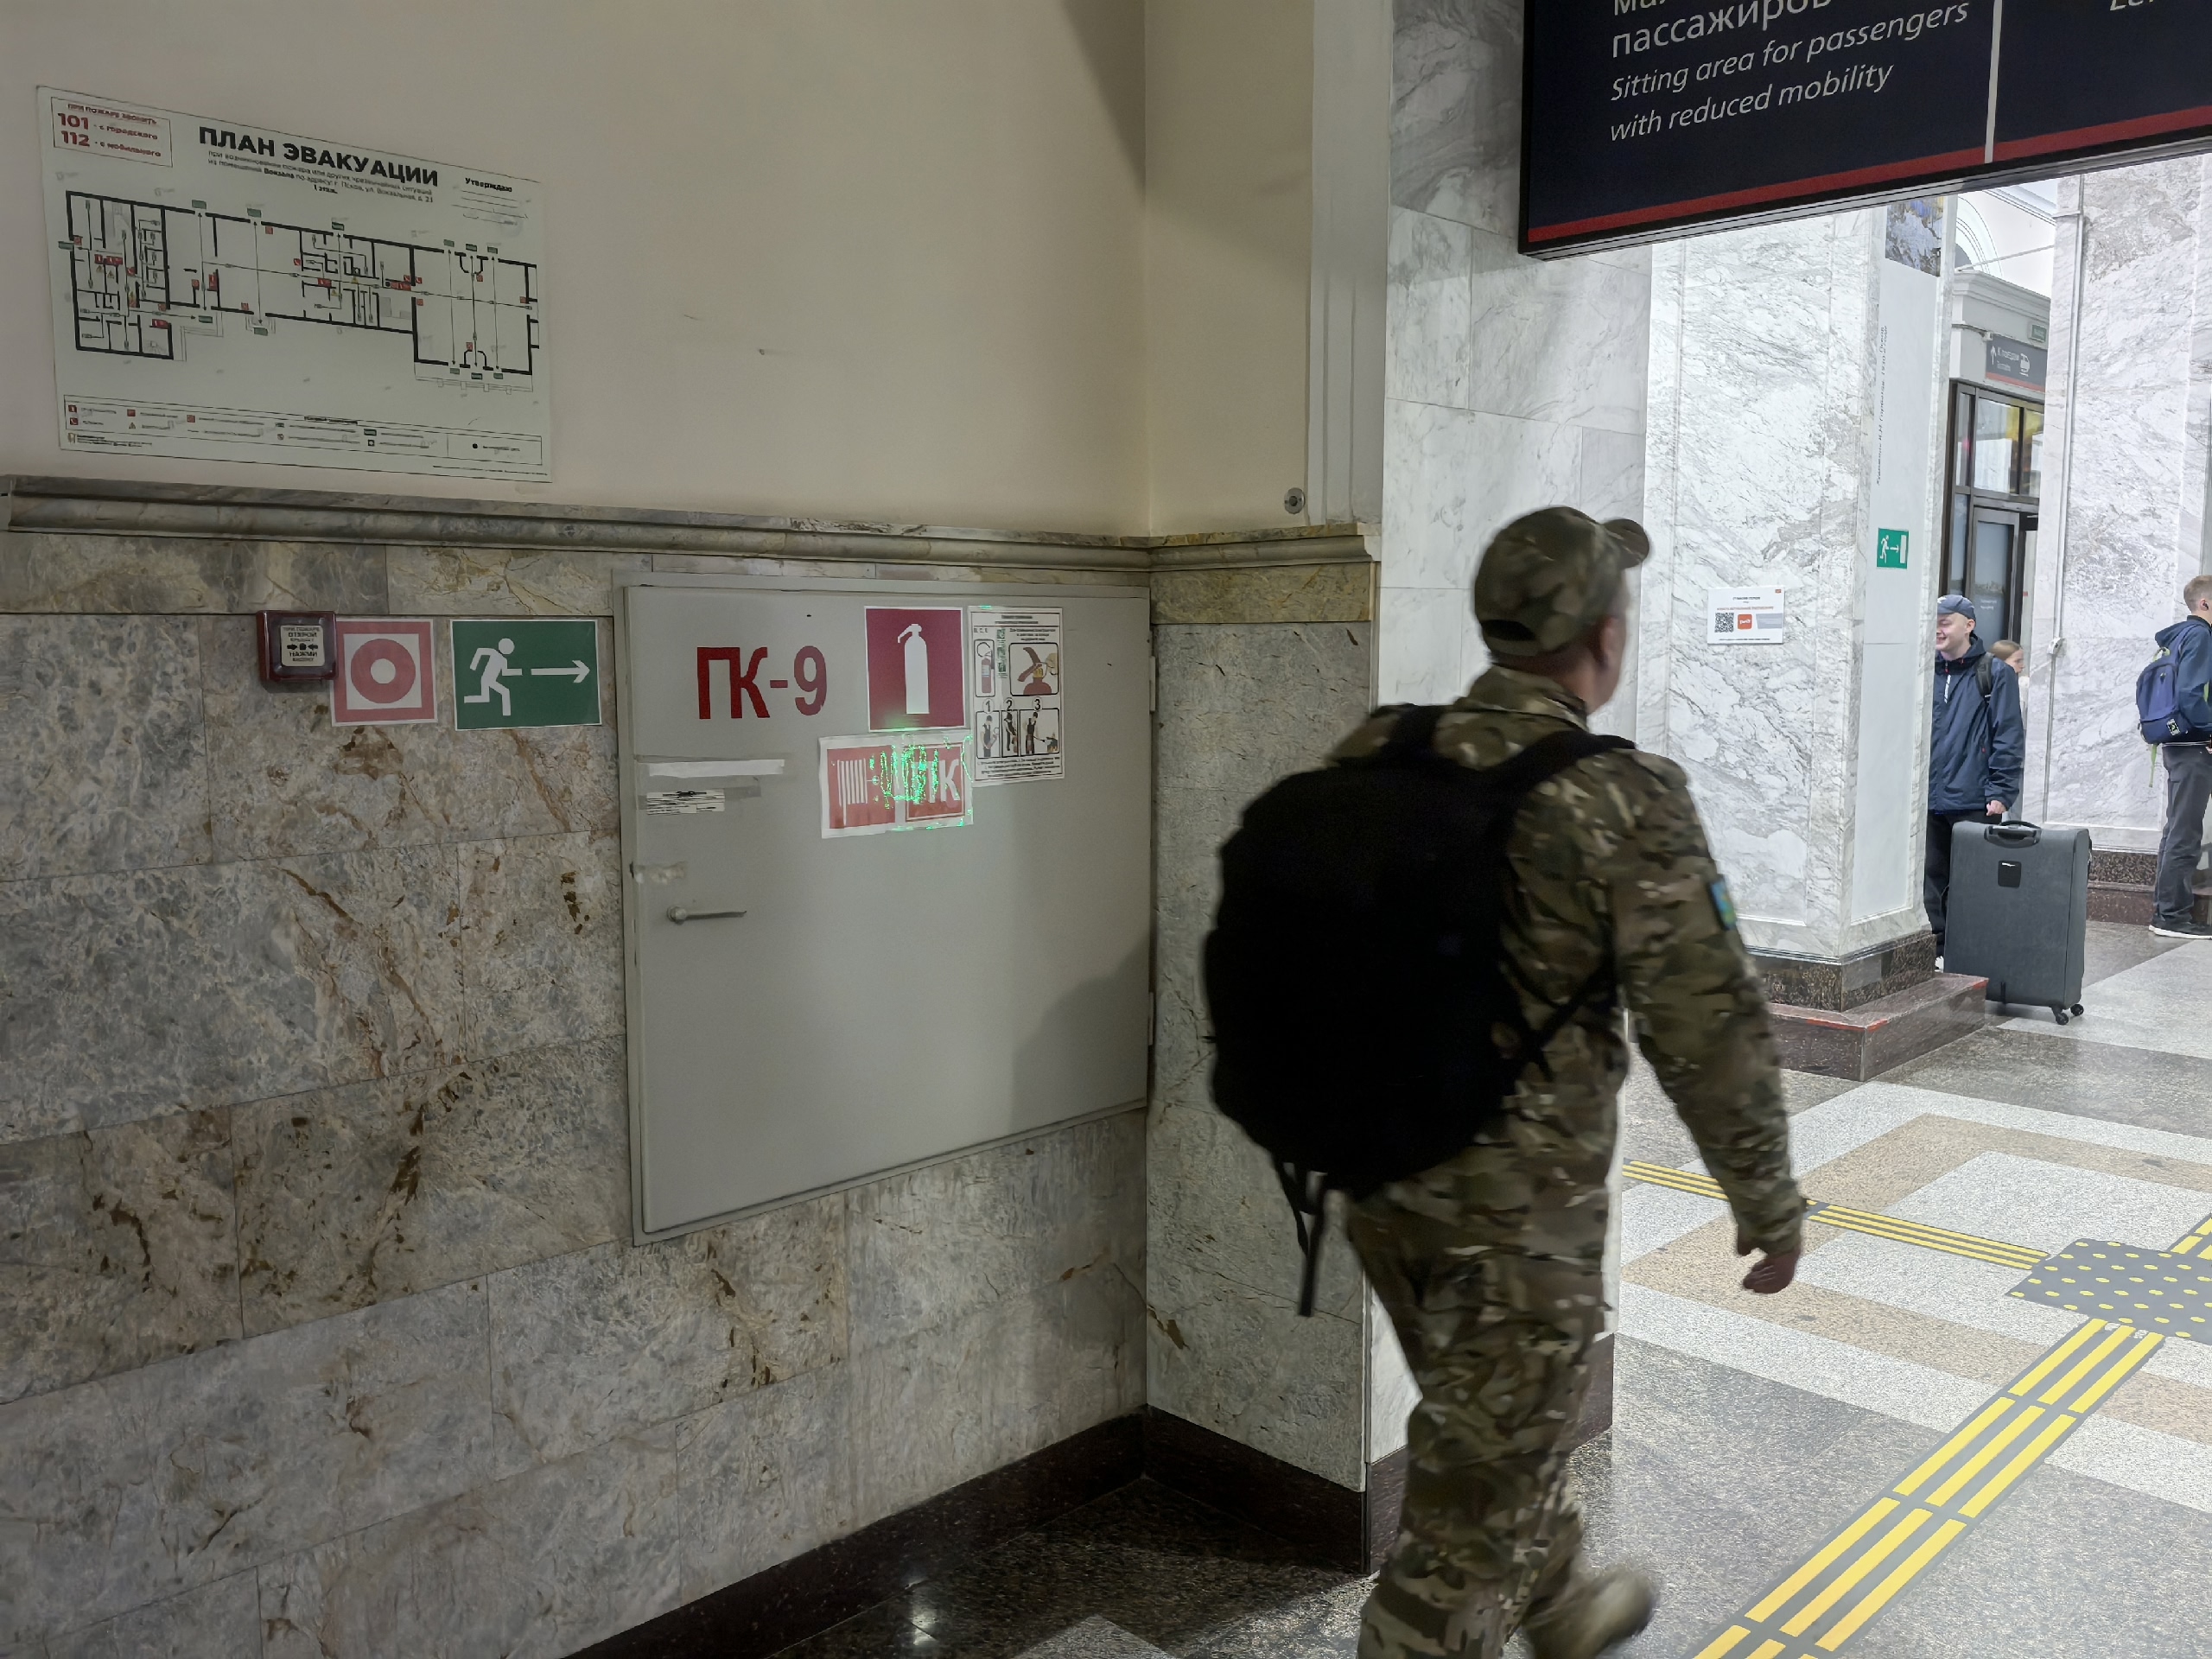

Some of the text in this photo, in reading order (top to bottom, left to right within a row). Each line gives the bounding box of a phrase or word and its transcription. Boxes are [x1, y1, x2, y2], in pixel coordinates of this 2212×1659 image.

[1611, 2, 1968, 101] Sitting area for passengers
[58, 112, 89, 130] 101
[1610, 62, 1895, 142] with reduced mobility
[61, 130, 91, 148] 112
[199, 126, 438, 188] ПЛАН ЭВАКУАЦИИ
[696, 645, 828, 720] ПК-9
[1006, 699, 1013, 711] 2
[1033, 698, 1041, 711] 3
